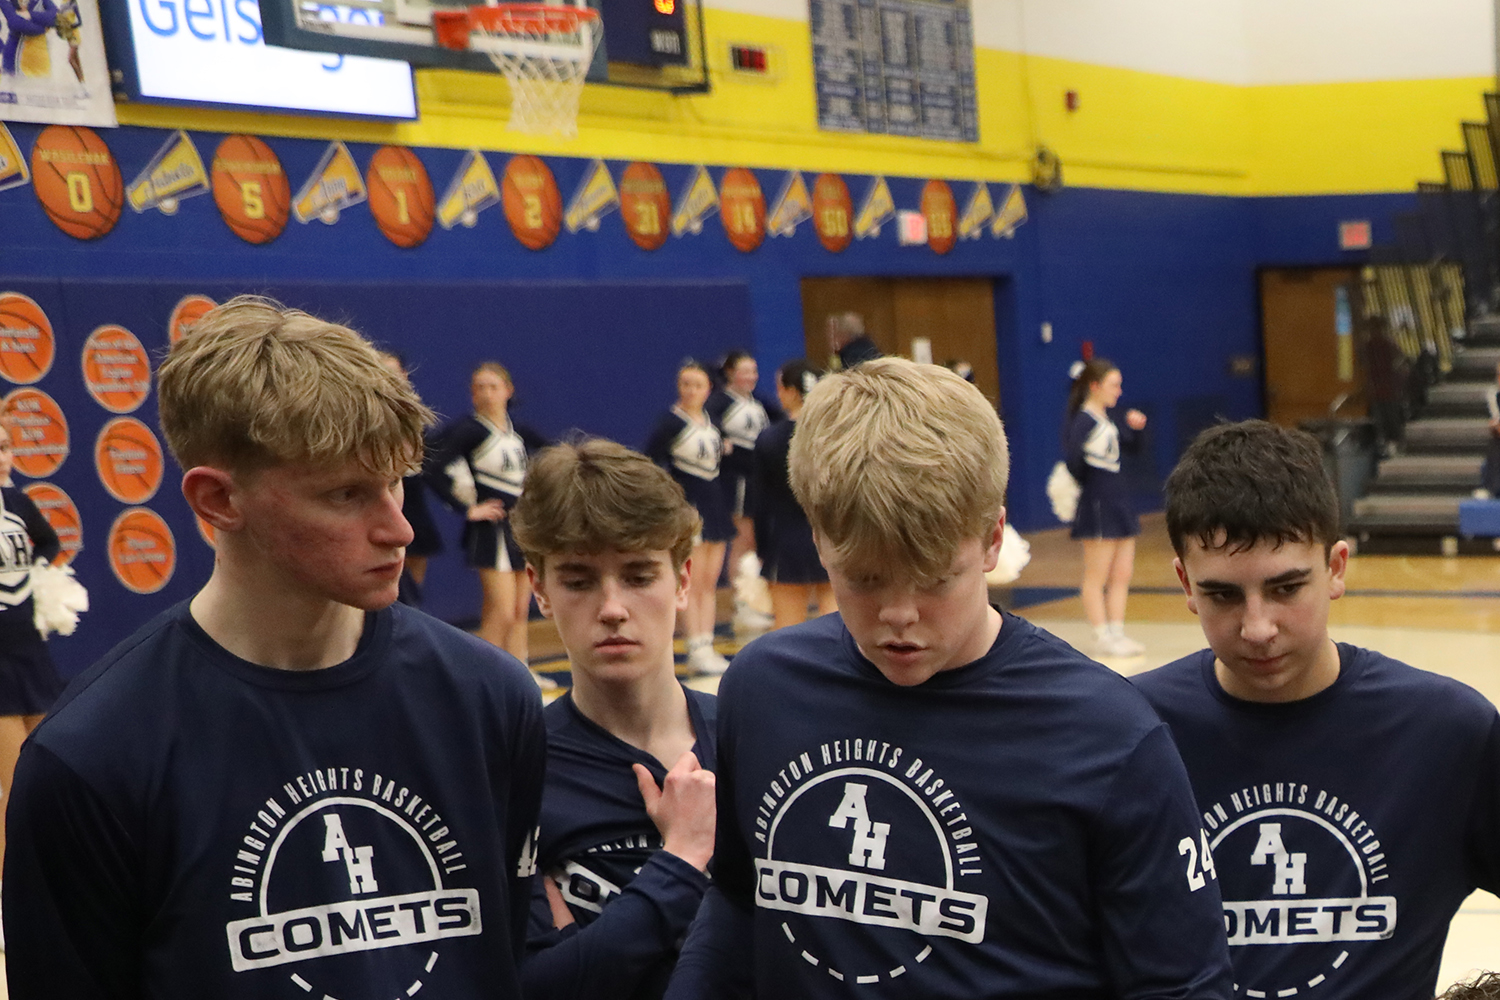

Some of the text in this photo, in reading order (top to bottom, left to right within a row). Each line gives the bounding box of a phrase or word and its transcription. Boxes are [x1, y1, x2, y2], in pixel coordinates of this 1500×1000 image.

[67, 171, 92, 212] 0
[242, 181, 265, 219] 5
[396, 189, 410, 225] 1
[524, 195, 543, 228] 2
[230, 767, 467, 902] ABINGTON HEIGHTS BASKETBALL
[754, 738, 983, 877] ABINGTON HEIGHTS BASKETBALL
[828, 782, 891, 870] AH
[1230, 782, 1389, 884] HEIGHTS BASKETBALL
[321, 813, 379, 894] AH
[1178, 828, 1217, 892] 24
[1250, 823, 1307, 895] AH
[238, 896, 472, 961] COMETS
[758, 867, 978, 934] COMETS
